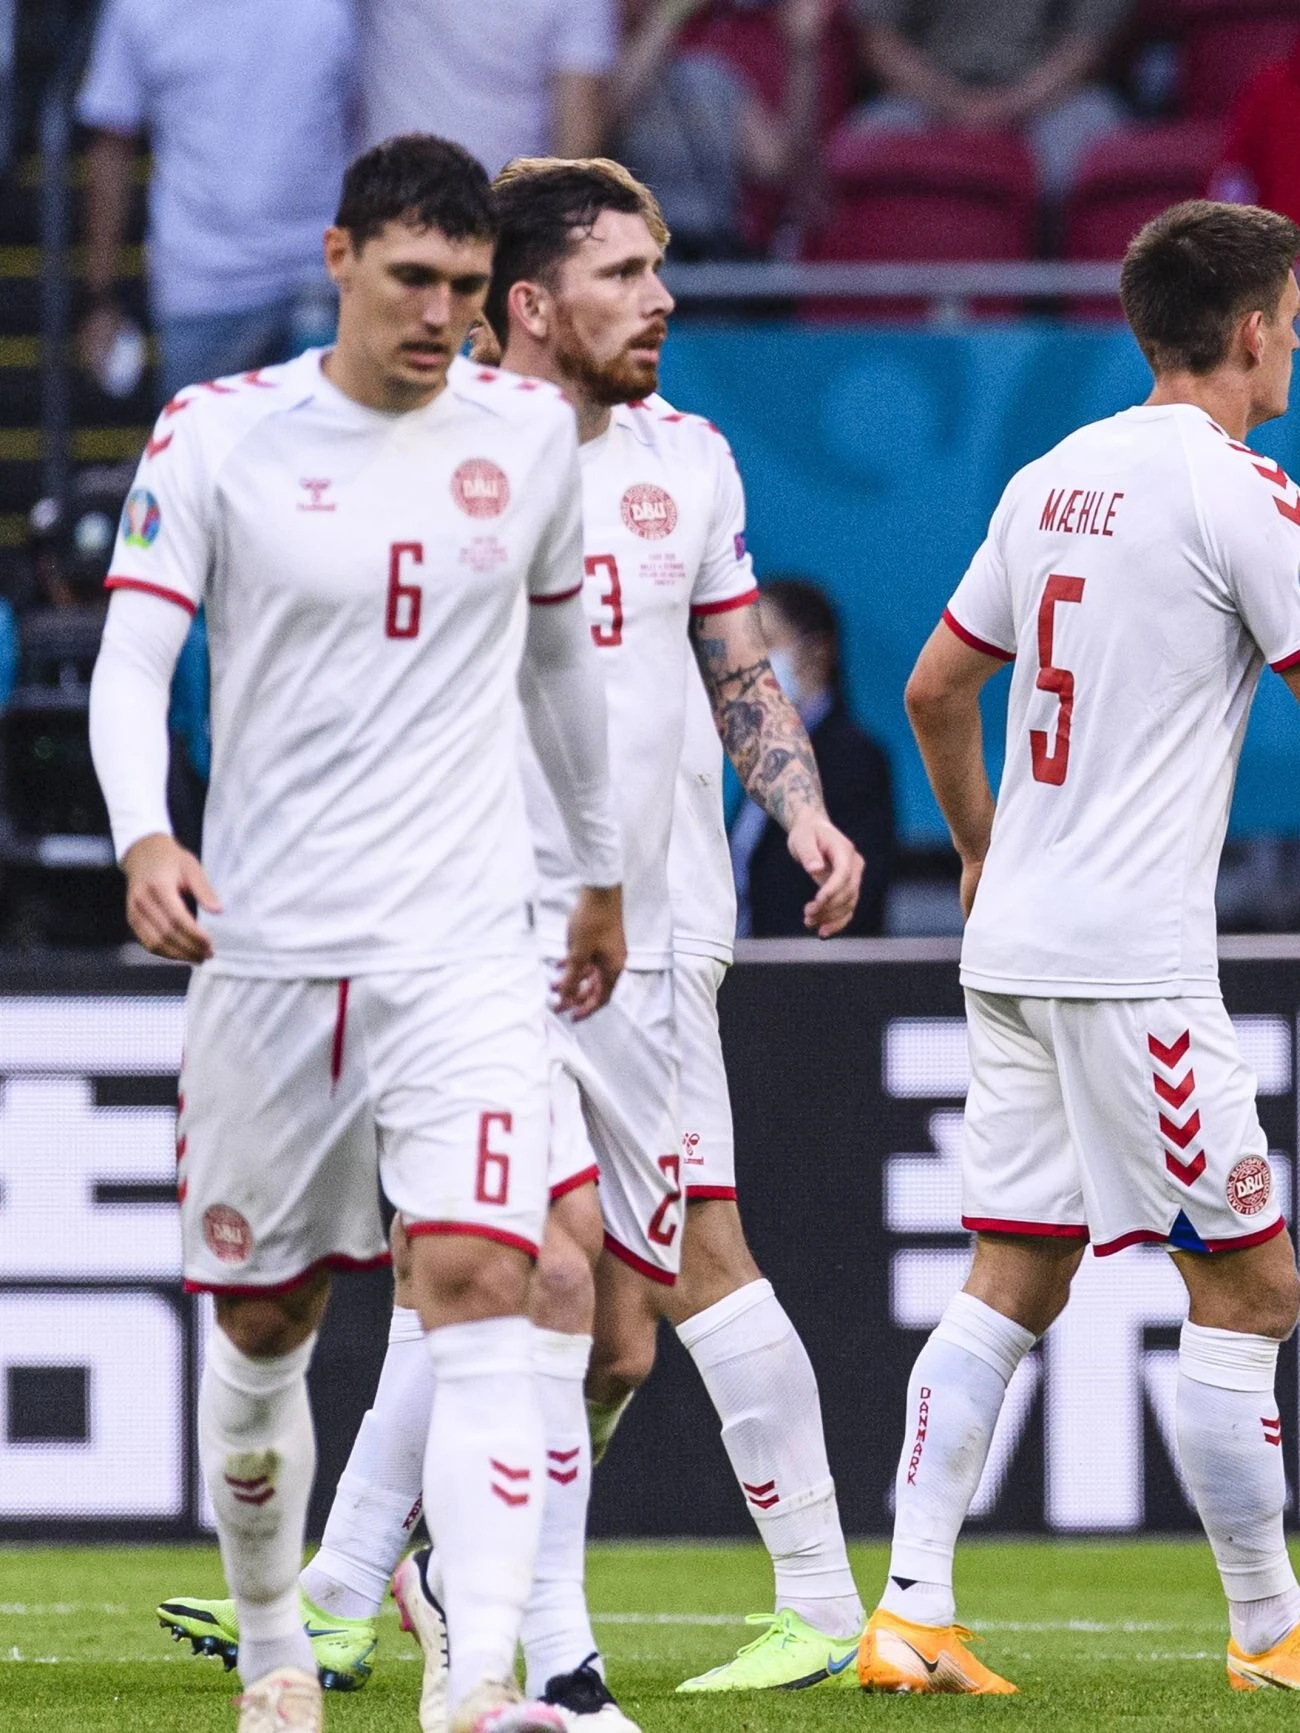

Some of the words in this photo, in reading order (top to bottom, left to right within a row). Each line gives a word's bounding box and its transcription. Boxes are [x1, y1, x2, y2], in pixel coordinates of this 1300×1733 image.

[1039, 488, 1125, 537] MÆHLE
[385, 541, 424, 640] 6
[1029, 573, 1086, 787] 5
[475, 1111, 513, 1206] 6
[1236, 1173, 1264, 1198] DBU
[907, 1386, 932, 1487] DANMARK
